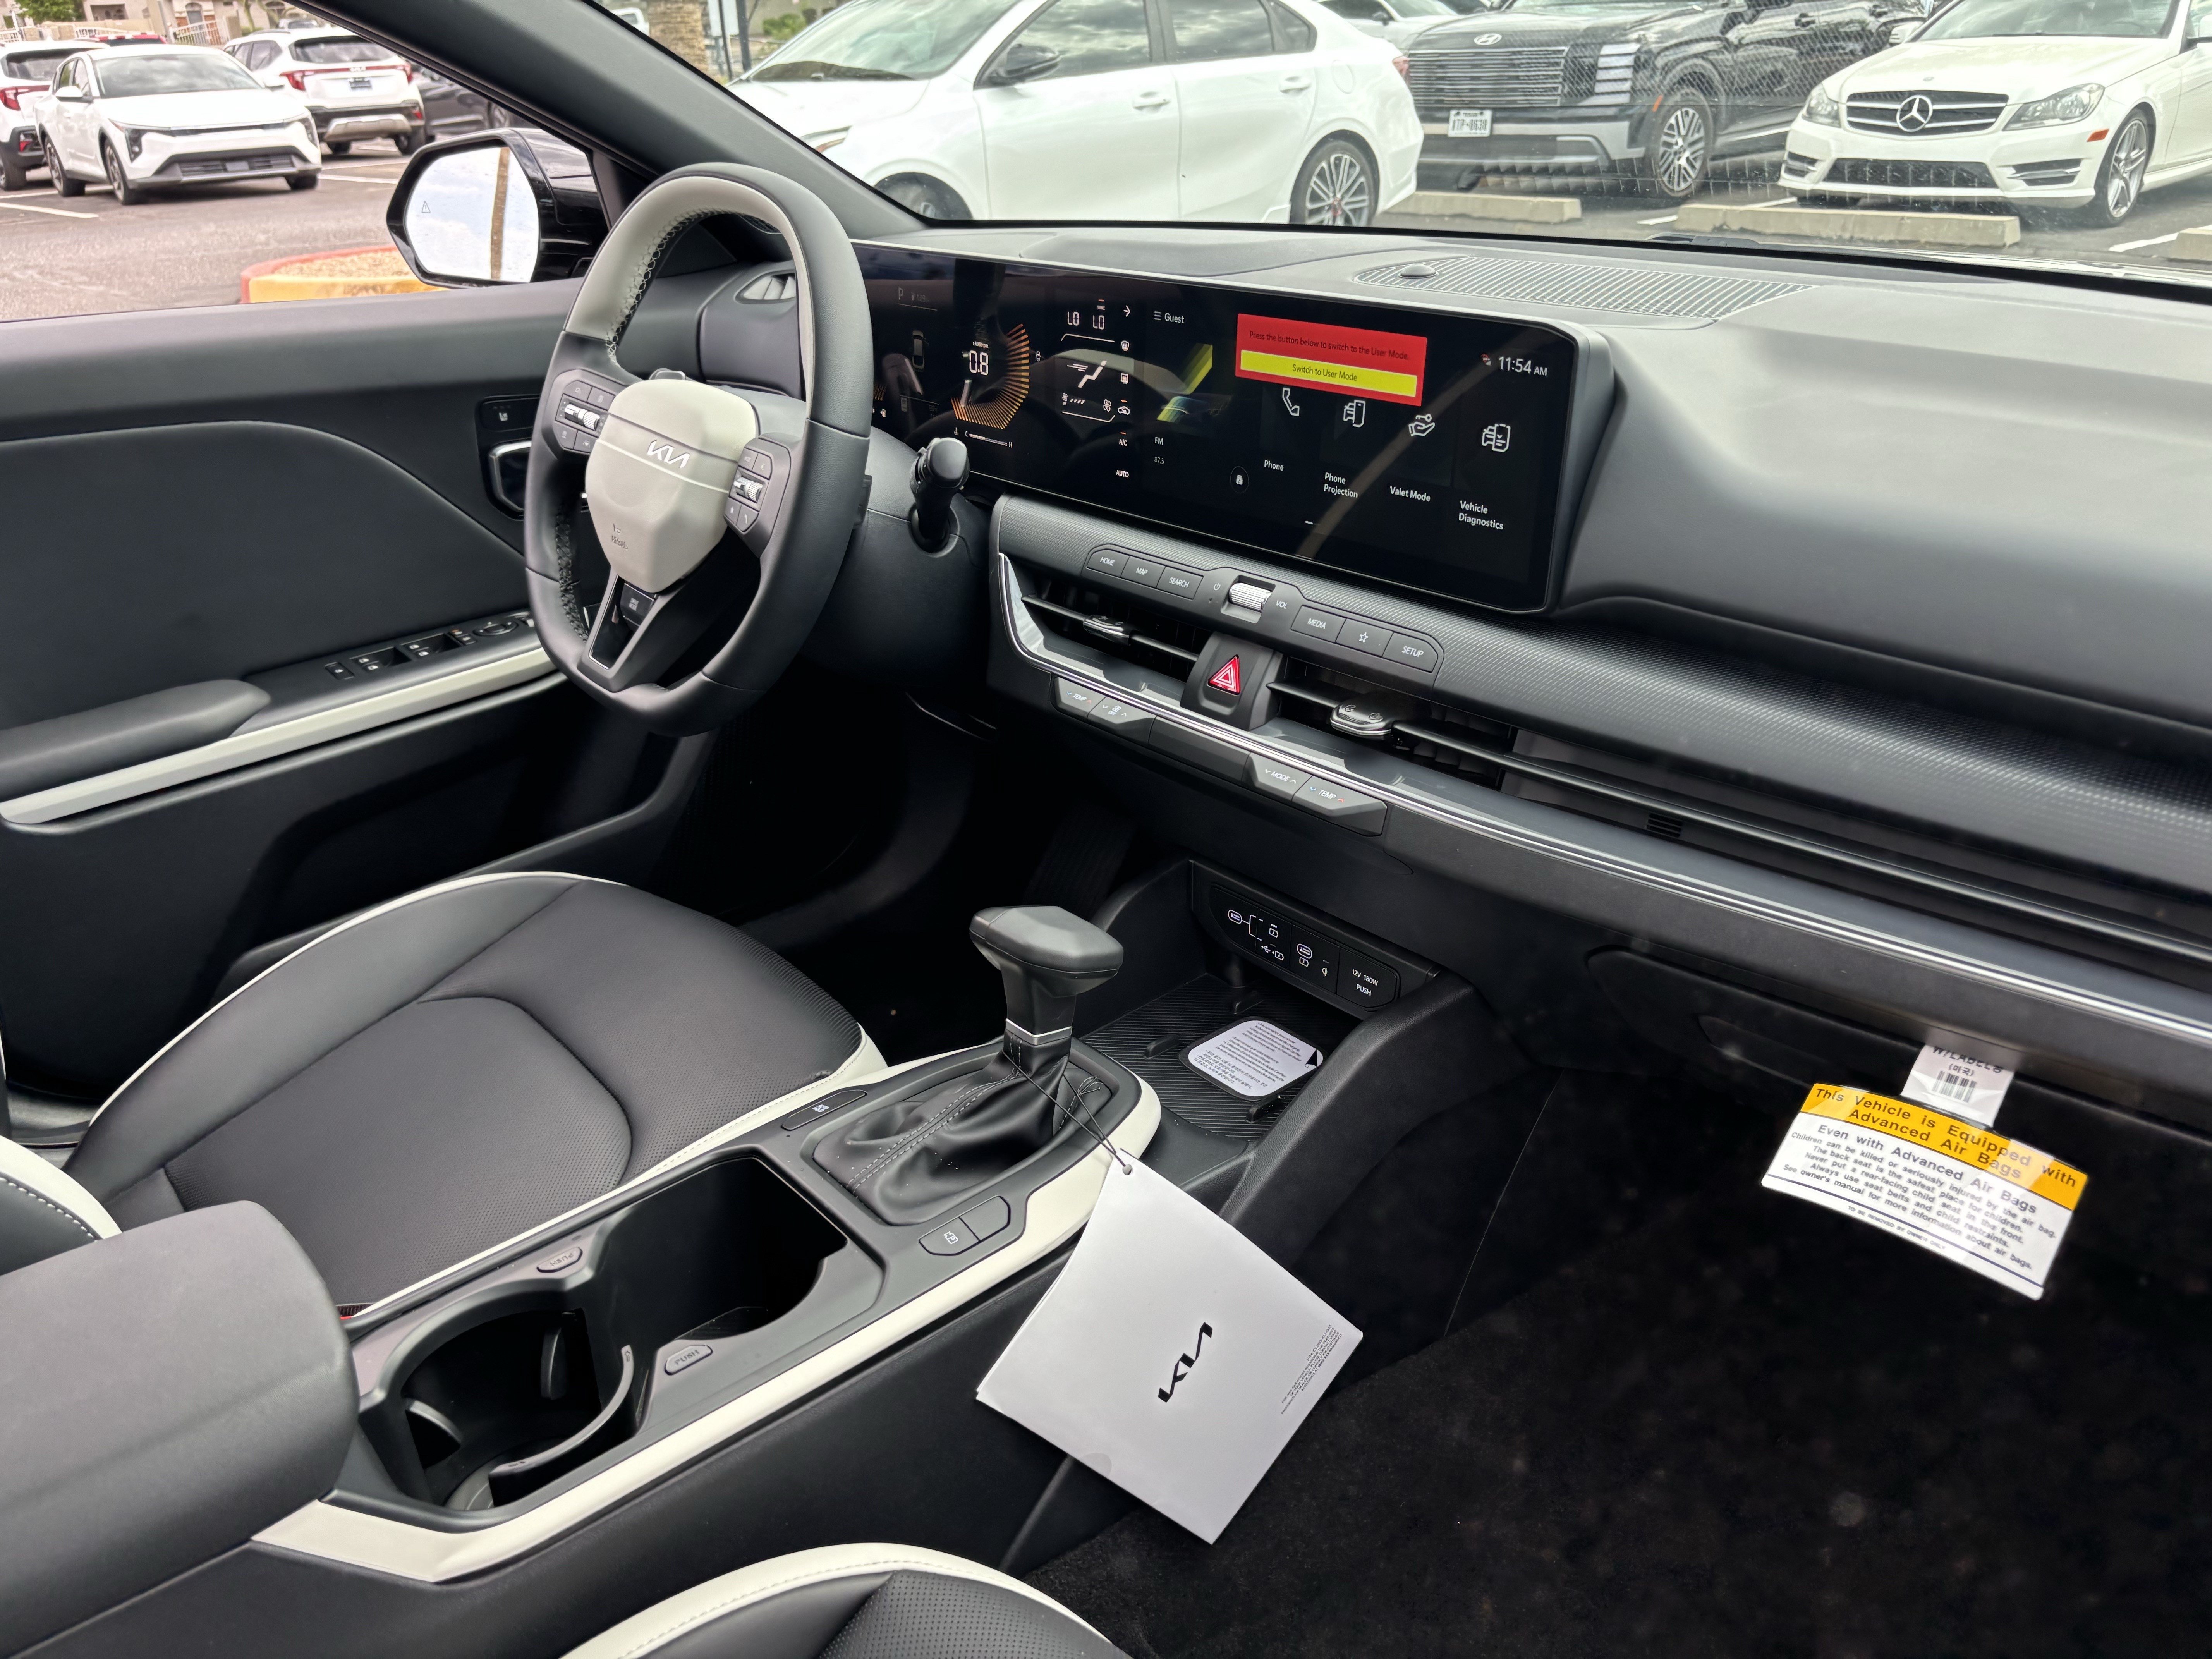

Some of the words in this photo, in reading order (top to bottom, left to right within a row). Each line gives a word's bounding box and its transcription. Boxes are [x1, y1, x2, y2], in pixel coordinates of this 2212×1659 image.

[1164, 313, 1184, 324] Guest
[1250, 331, 1265, 340] Press
[1266, 333, 1277, 342] the
[1278, 335, 1298, 345] button
[1300, 337, 1319, 347] below
[1328, 343, 1349, 351] switch
[1359, 346, 1369, 355] the
[1371, 347, 1386, 356] User
[969, 350, 988, 376] 0.8
[1499, 356, 1532, 374] 11:54
[1534, 366, 1547, 376] AM
[1293, 364, 1313, 374] Switch
[1323, 368, 1337, 378] User
[1339, 371, 1357, 382] Mode
[1154, 436, 1163, 445] FM
[647, 440, 690, 468] KIA
[1264, 460, 1284, 471] Phone
[1116, 469, 1129, 478] AUTO
[1325, 472, 1346, 484] Phone
[1324, 484, 1358, 498] Projection
[1390, 486, 1409, 498] Valet
[1410, 490, 1431, 502] Mode
[1460, 500, 1488, 514] Vehicle
[1458, 512, 1503, 530] Diagnostics
[1100, 556, 1115, 566] HOME
[1136, 567, 1148, 575] MAP
[1169, 577, 1190, 588] SEARCH
[1276, 600, 1287, 609] VOL
[1307, 618, 1326, 629] MEDIA
[1401, 646, 1424, 658] SETUP
[1271, 771, 1291, 782] MODE
[1318, 789, 1336, 799] TEMP
[1353, 969, 1361, 977] 12V
[1364, 975, 1378, 986] 180W
[1357, 984, 1371, 996] PUSH
[1949, 1063, 1974, 1077] (미국)
[1816, 1088, 1844, 1102] This
[1856, 1096, 1911, 1119] Vehicle
[1921, 1115, 1936, 1128] is
[1947, 1124, 2031, 1166] Equipped
[2042, 1165, 2076, 1187] with
[1848, 1109, 1931, 1142] Advanced
[1940, 1139, 1967, 1155] Air
[1977, 1152, 2021, 1178] Bags
[1818, 1125, 1848, 1139] Even
[1856, 1136, 1884, 1150] with
[1891, 1147, 1964, 1181] Advanced
[1970, 1178, 1993, 1193] Air
[2000, 1190, 2036, 1214] Bags
[1791, 1132, 1822, 1144] Children
[1860, 1150, 1884, 1163] killed
[1903, 1166, 1945, 1187] seriously
[1949, 1183, 1982, 1202] injured
[1986, 1200, 1998, 1211] by
[2003, 1208, 2017, 1219] the
[2021, 1218, 2034, 1226] air
[2038, 1224, 2056, 1238] bag.
[1813, 1146, 1827, 1154] The
[1830, 1150, 1850, 1161] back
[1853, 1158, 1872, 1168] seat
[1888, 1170, 1902, 1180] the
[1907, 1178, 1936, 1193] safest
[1939, 1192, 1965, 1206] place
[1968, 1203, 1982, 1213] for
[1984, 1209, 2023, 1233] children.
[1805, 1152, 1828, 1163] Never
[1831, 1161, 1846, 1169] put
[1860, 1170, 1909, 1193] rear-facing
[1912, 1190, 1935, 1203] child
[1941, 1202, 1961, 1214] seat
[1966, 1211, 1976, 1220] in
[1981, 1219, 1997, 1230] the
[2000, 1227, 2023, 1244] front.
[1810, 1163, 1839, 1176] Always
[1844, 1174, 1859, 1183] use
[1863, 1181, 1883, 1192] seat
[1887, 1189, 1910, 1202] belts
[1914, 1200, 1932, 1212] and
[1936, 1210, 1961, 1224] child
[1964, 1223, 2009, 1248] restraints.
[1783, 1164, 1797, 1173] See
[1800, 1170, 1830, 1182] owner's
[1834, 1180, 1865, 1194] manual
[1868, 1191, 1881, 1200] for
[1884, 1199, 1907, 1212] more
[1911, 1208, 1962, 1235] information
[1965, 1232, 1991, 1249] about
[1994, 1247, 2006, 1256] air
[2010, 1254, 2032, 1270] bags.
[550, 1253, 574, 1266] PUSH
[675, 1350, 699, 1365] PUSH
[1158, 1322, 1213, 1403] KIA
